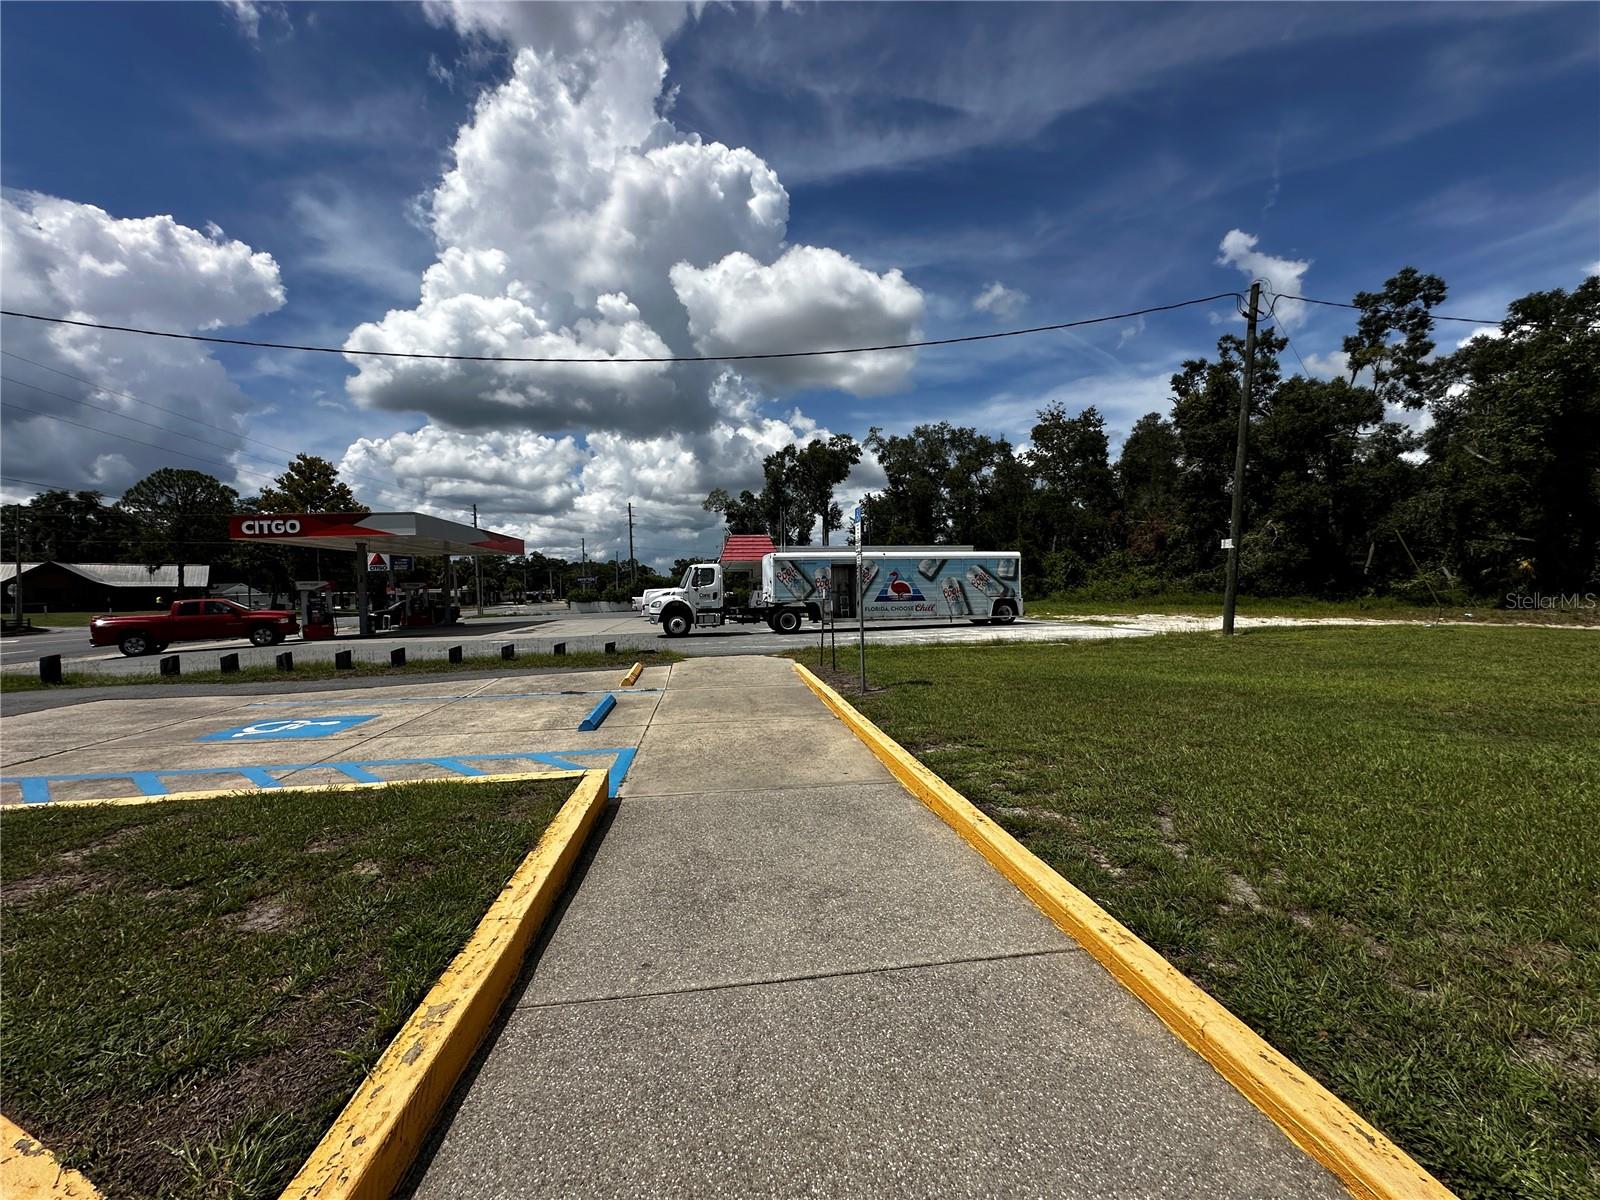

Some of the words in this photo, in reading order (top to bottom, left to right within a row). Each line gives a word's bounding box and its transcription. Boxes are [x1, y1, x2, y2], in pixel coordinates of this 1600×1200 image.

[241, 519, 300, 534] CITGO
[890, 604, 914, 612] CHOOSE
[914, 603, 936, 612] Chill
